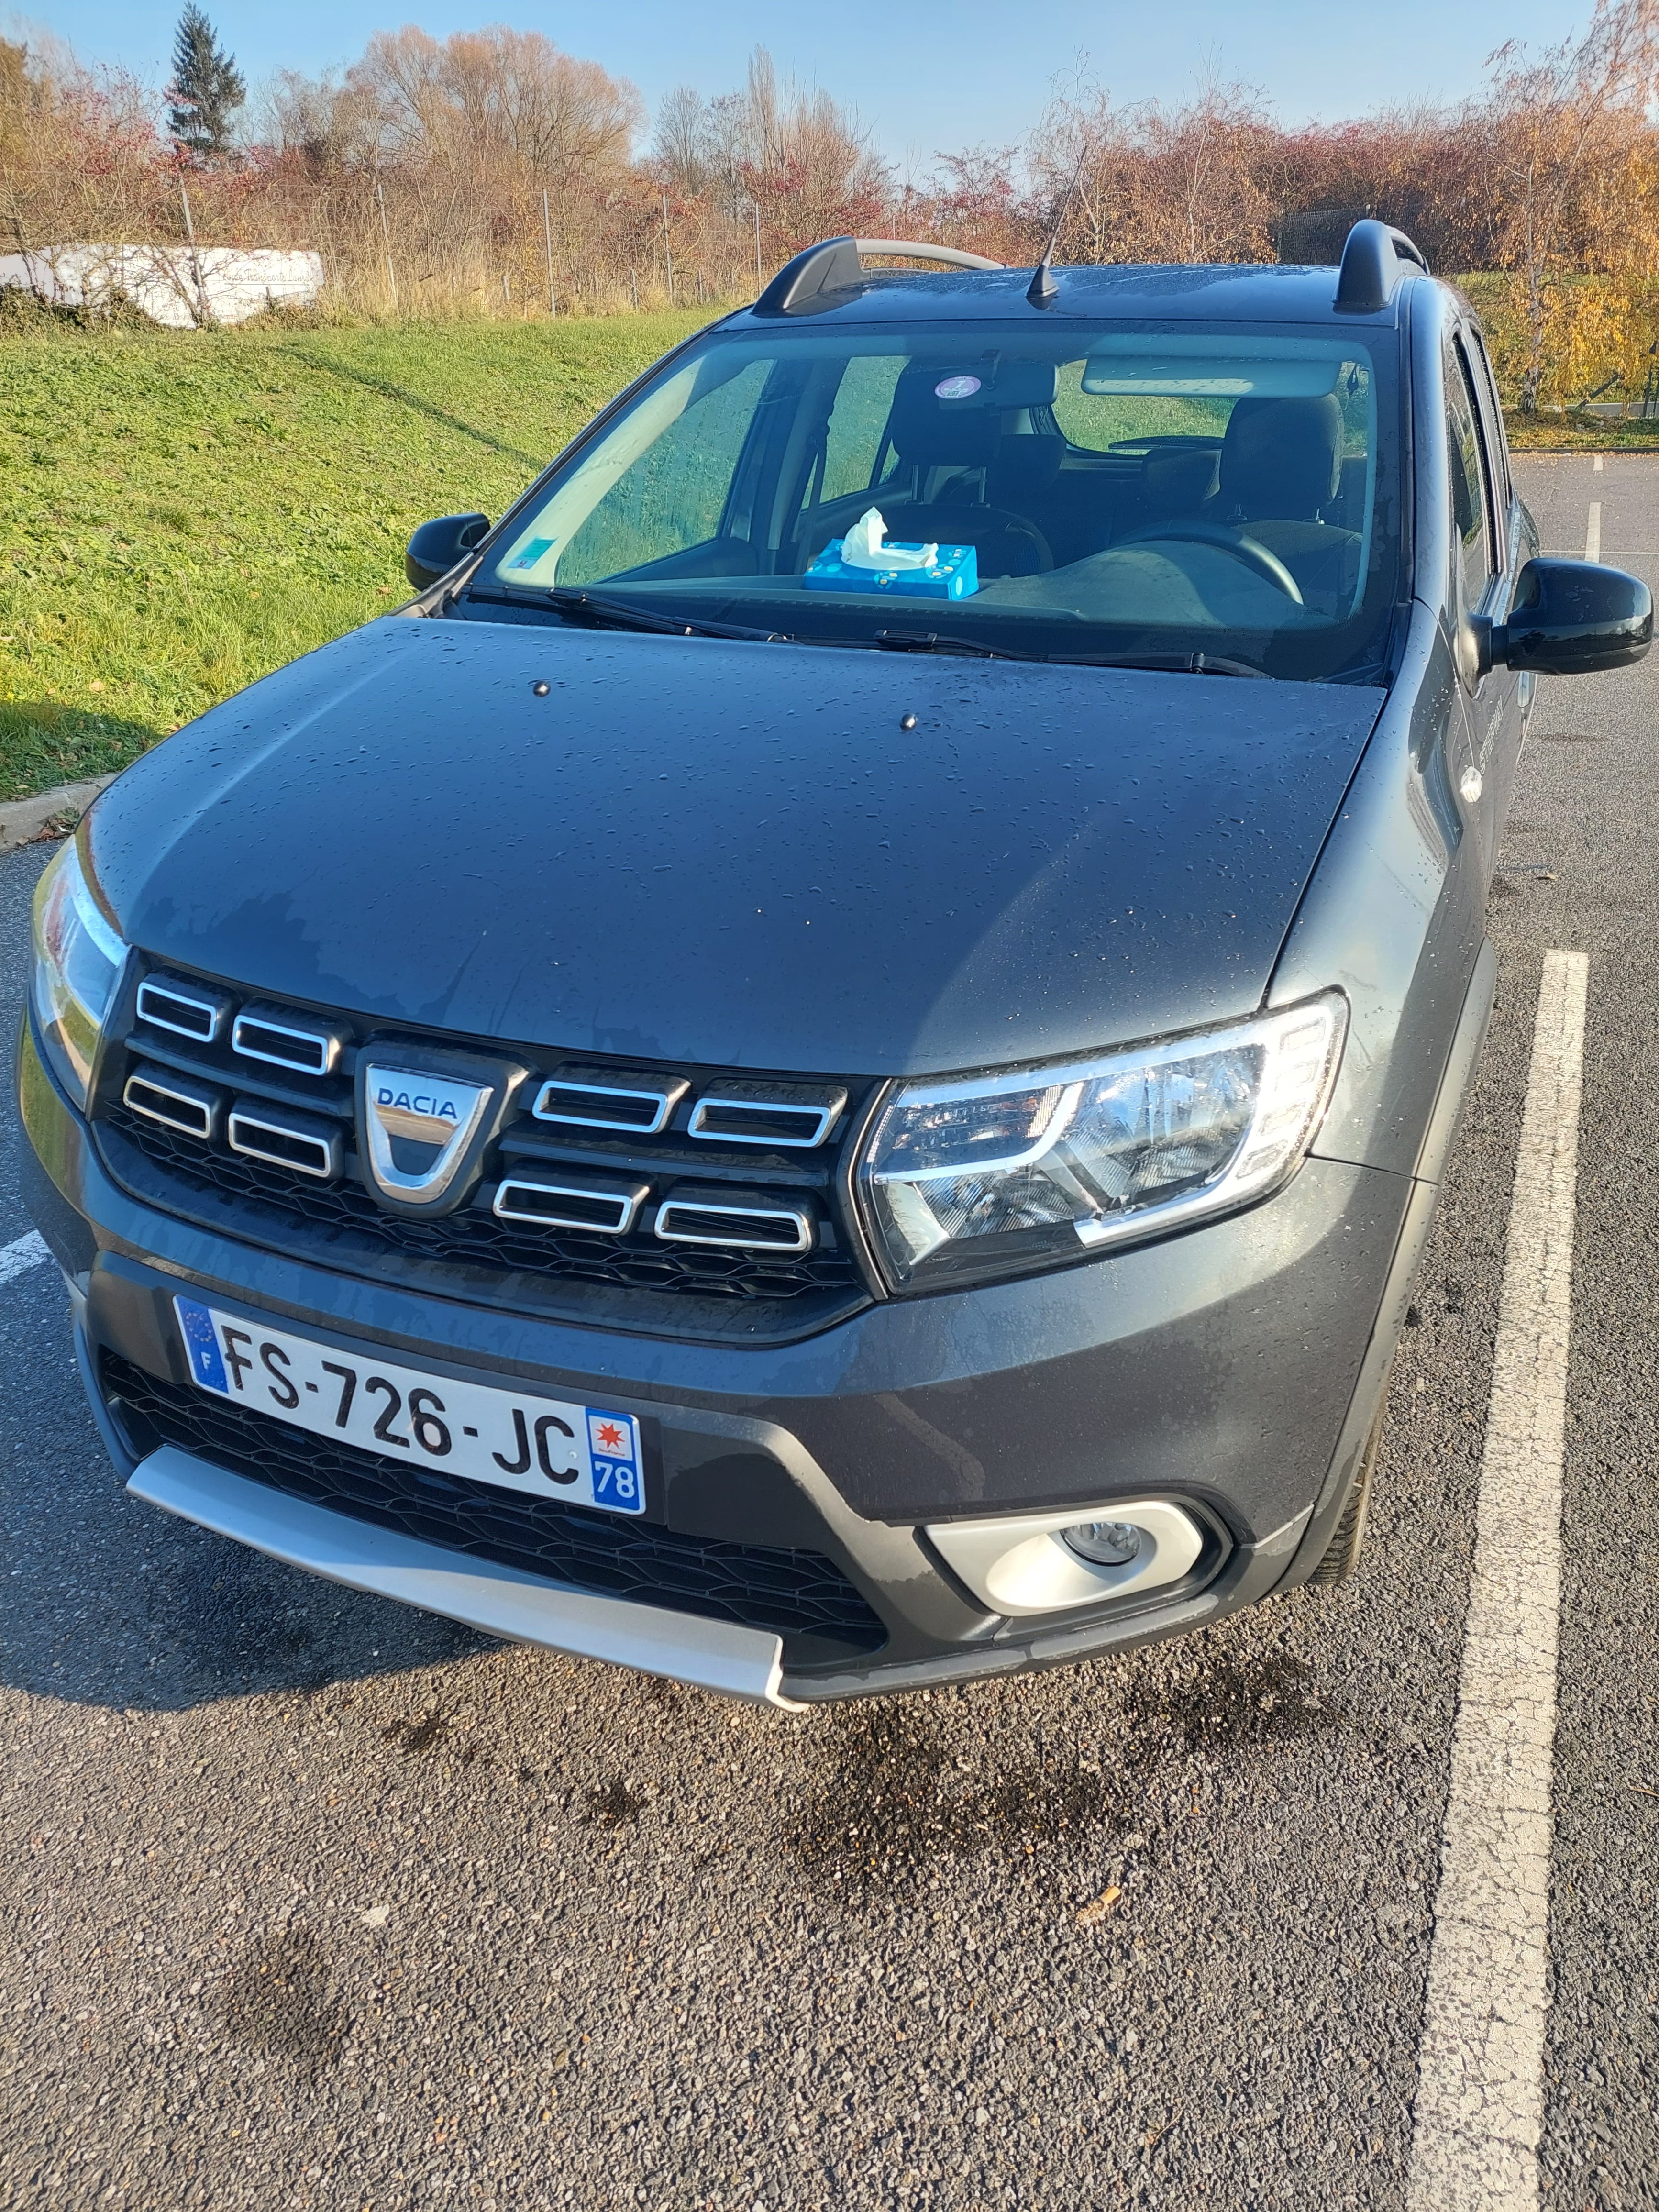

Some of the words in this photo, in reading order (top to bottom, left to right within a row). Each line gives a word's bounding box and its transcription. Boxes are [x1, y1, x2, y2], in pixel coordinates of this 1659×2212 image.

[1479, 695, 1504, 775] STEPWAY
[377, 1087, 458, 1120] DACIA
[200, 1351, 211, 1370] F
[594, 1460, 635, 1499] 78
